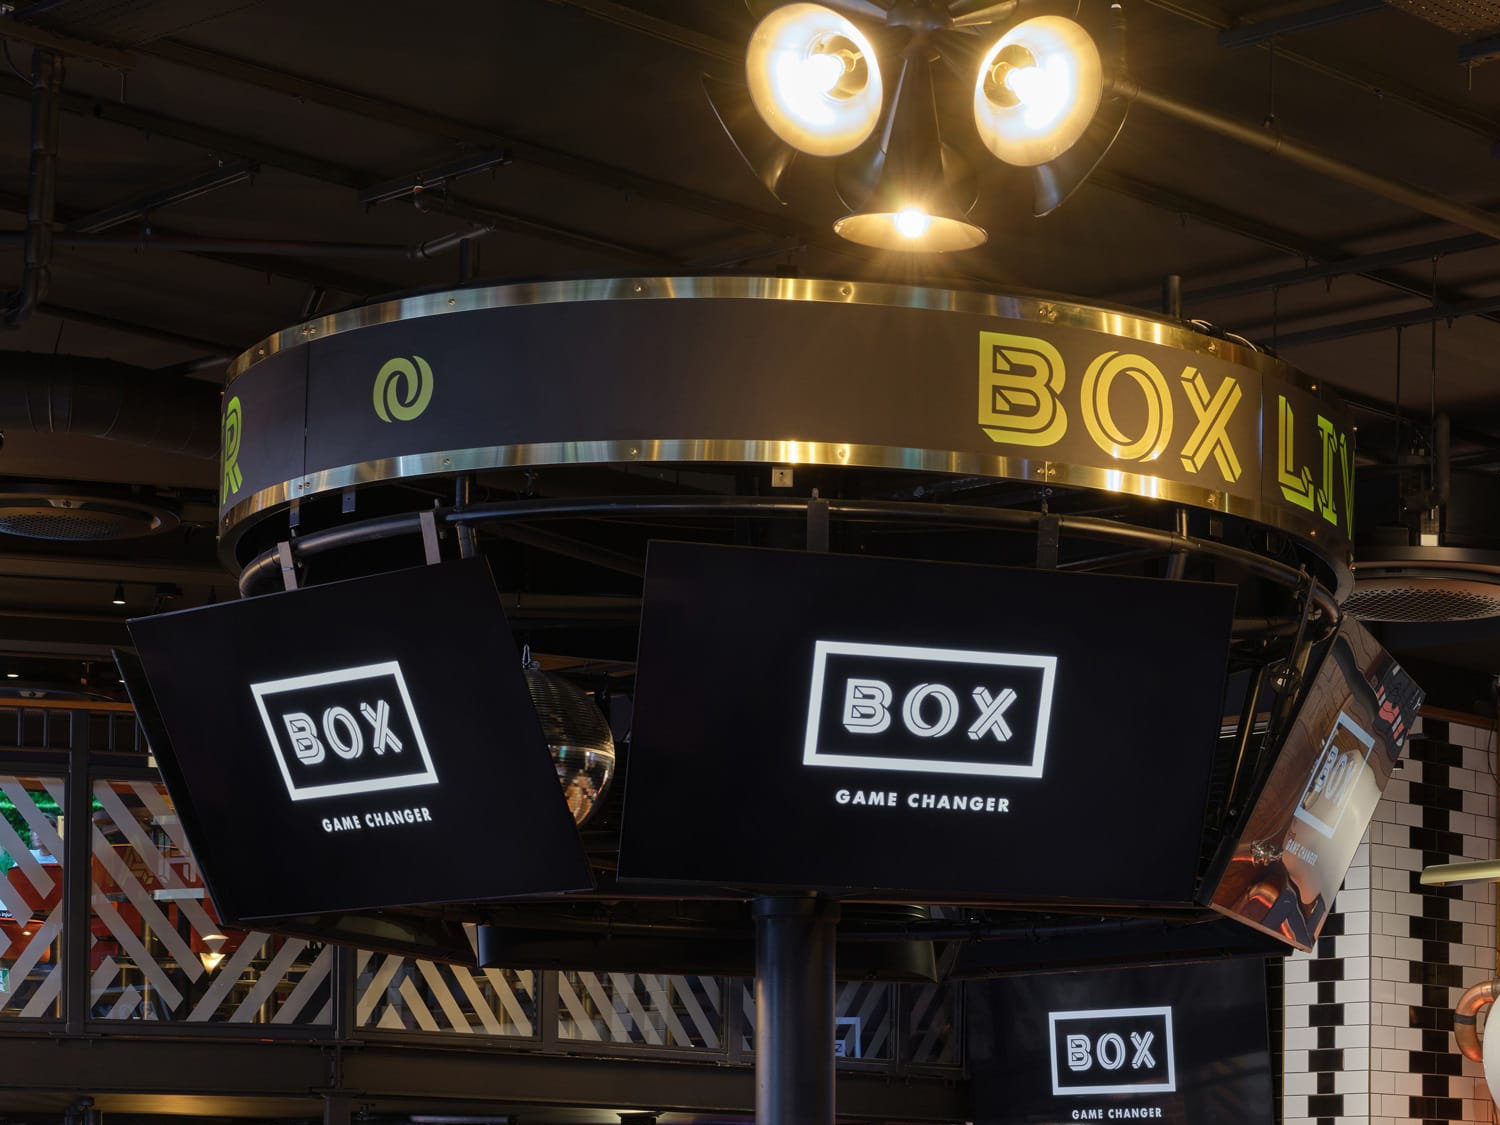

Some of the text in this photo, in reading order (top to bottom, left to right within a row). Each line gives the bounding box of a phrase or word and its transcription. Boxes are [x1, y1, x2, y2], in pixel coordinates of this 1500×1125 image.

[978, 330, 1242, 483] BOX
[843, 678, 1017, 742] BOX
[282, 700, 403, 765] BOX
[322, 807, 432, 832] GAME CHANGER
[835, 789, 1010, 812] GAME CHANGER
[1066, 1031, 1156, 1071] BOX
[1071, 1107, 1163, 1120] GAME CHANGER
